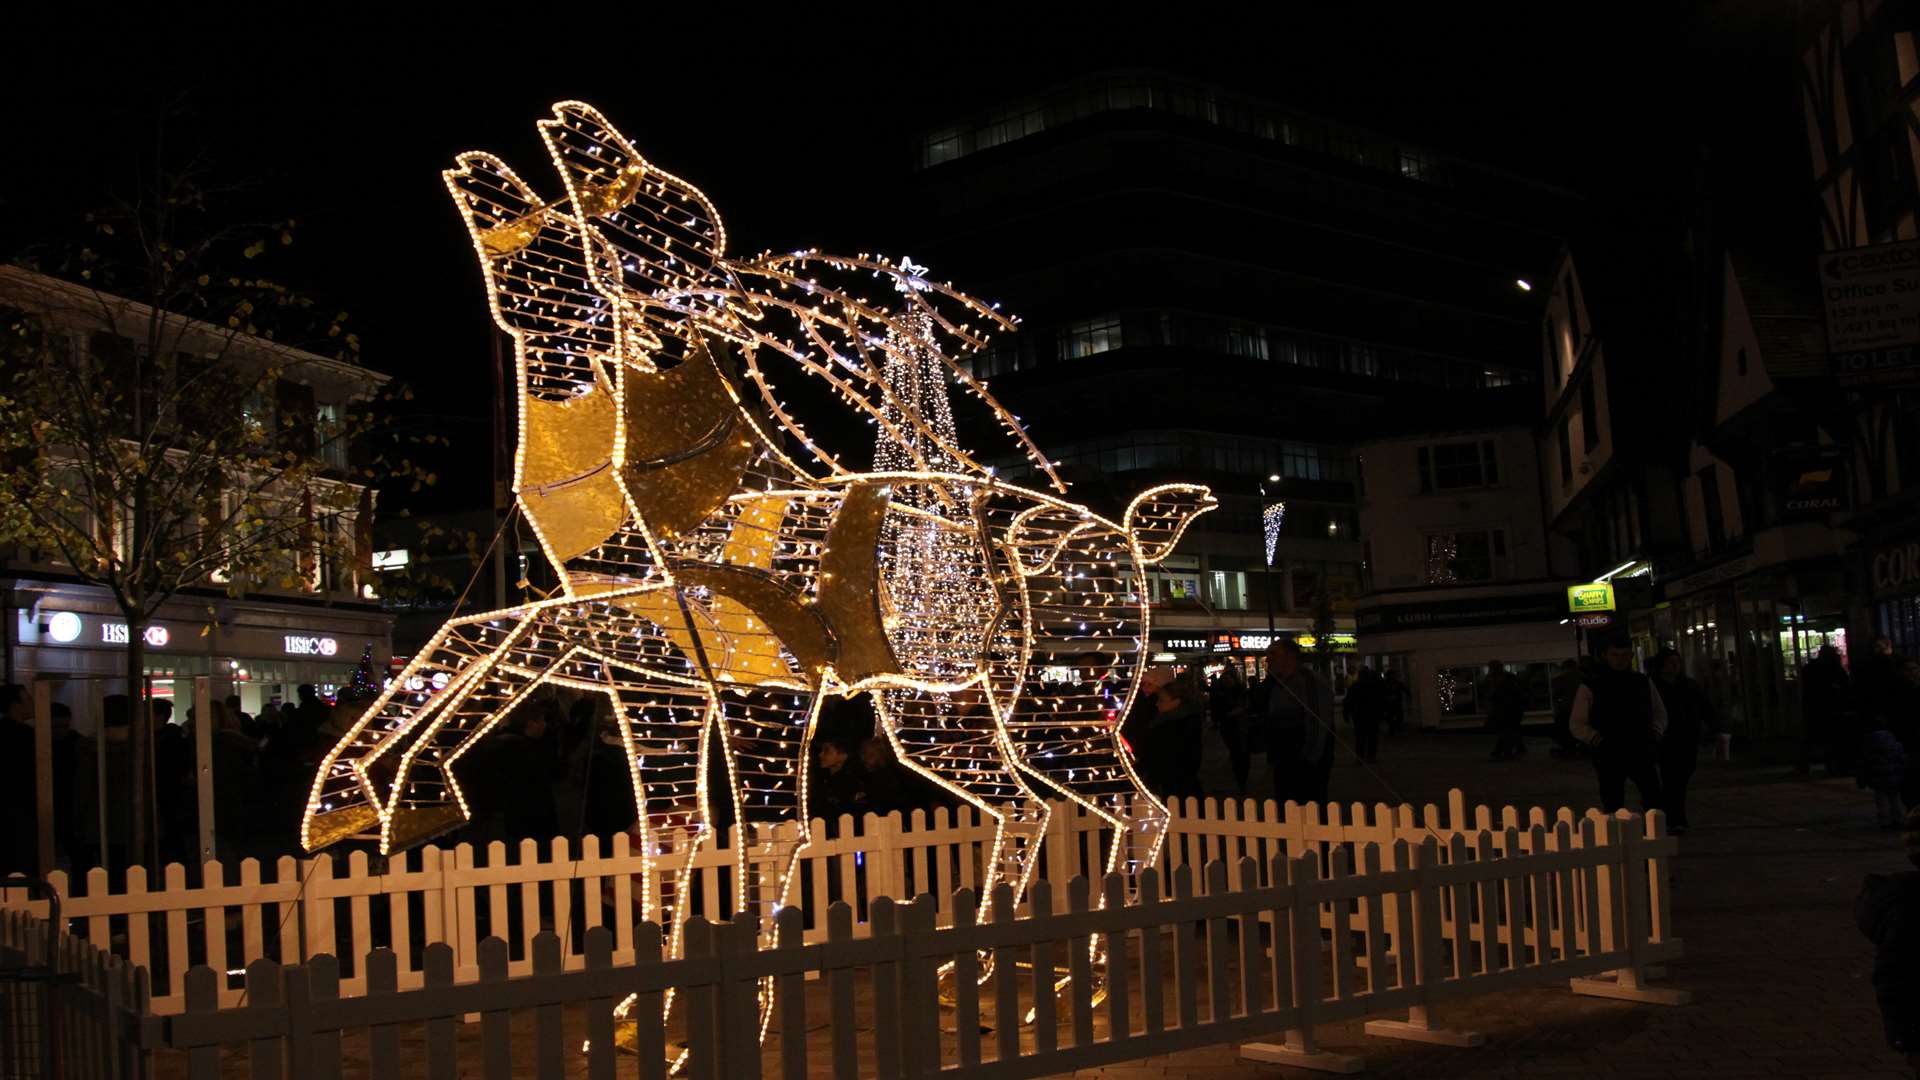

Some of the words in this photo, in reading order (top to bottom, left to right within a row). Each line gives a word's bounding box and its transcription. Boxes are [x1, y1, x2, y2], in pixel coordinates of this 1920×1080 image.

[1827, 283, 1886, 301] Office
[1837, 353, 1867, 371] TO
[1785, 497, 1839, 511] CORAL
[1579, 616, 1608, 626] studio
[284, 636, 320, 655] HSBC
[1167, 639, 1207, 648] STREET
